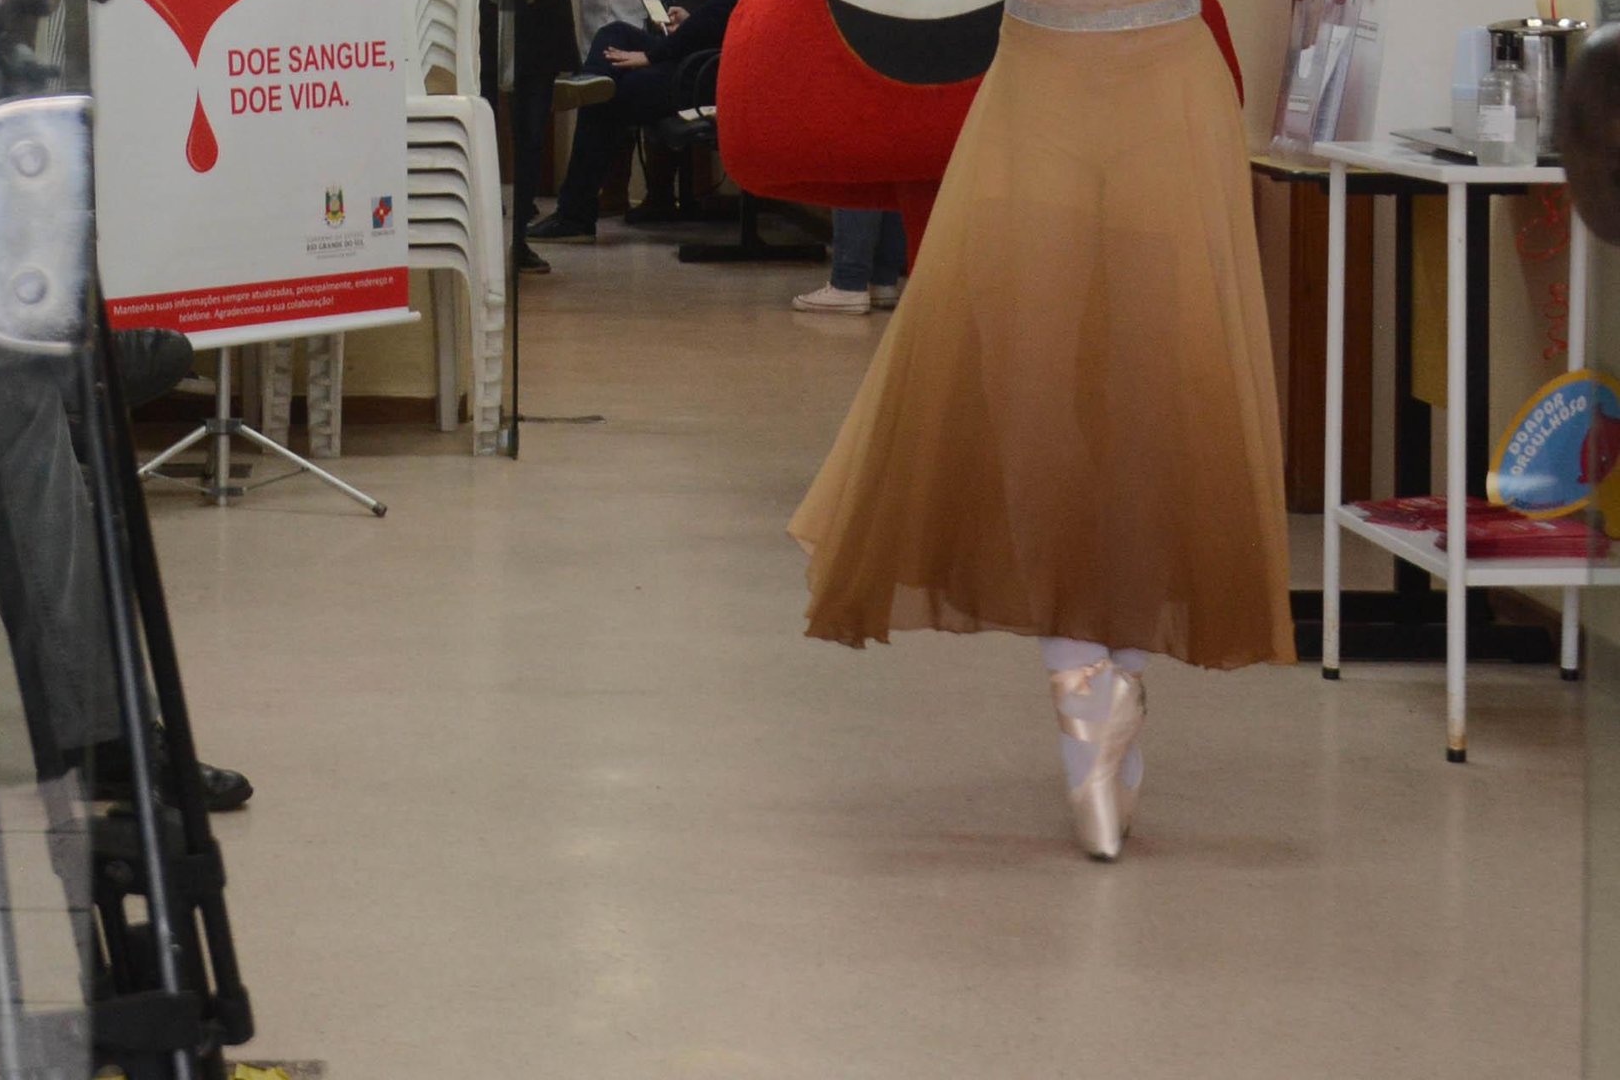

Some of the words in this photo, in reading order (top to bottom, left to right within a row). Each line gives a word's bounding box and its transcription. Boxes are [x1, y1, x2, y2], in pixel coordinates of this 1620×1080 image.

[227, 47, 281, 77] DOE
[288, 40, 395, 73] SANGUE,
[230, 85, 283, 115] DOE
[289, 80, 350, 110] VIDA.
[112, 301, 155, 317] Mantenha
[155, 299, 173, 311] suas
[174, 293, 221, 308] informações
[222, 290, 251, 304] sempre
[354, 276, 388, 290] endereço
[214, 303, 265, 321] Agradecemos
[272, 301, 286, 312] sua
[1508, 392, 1564, 456] DOADOR
[1510, 395, 1588, 476] ORGULHOSO
